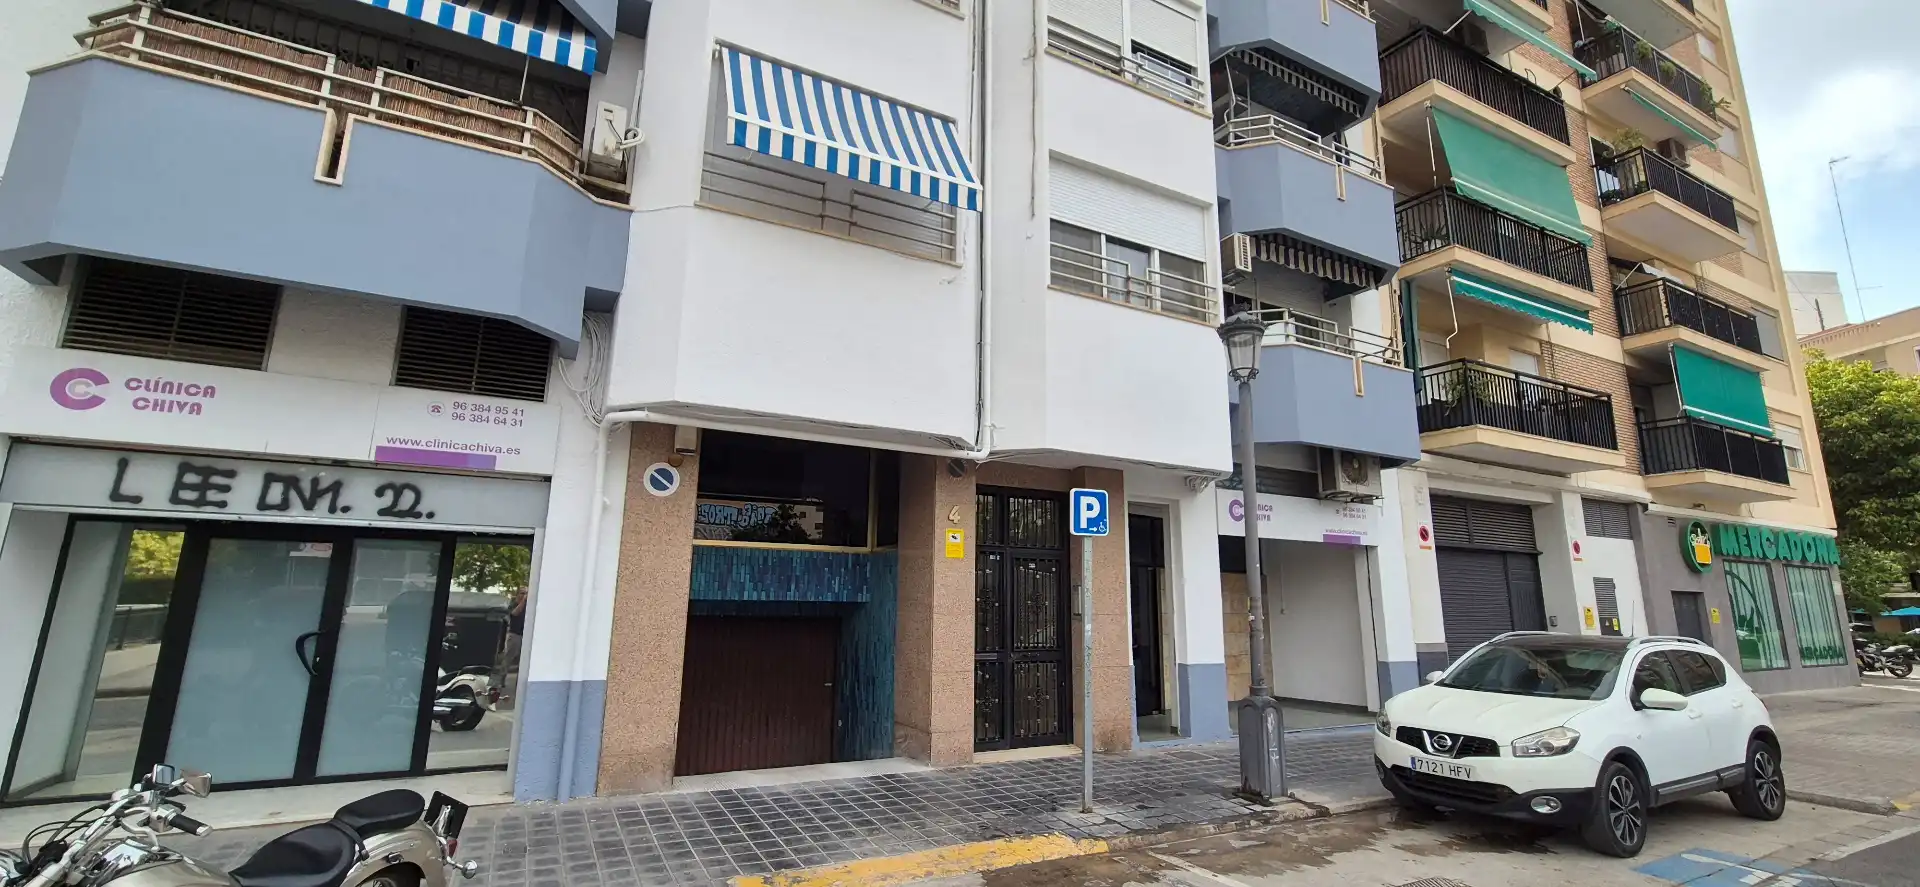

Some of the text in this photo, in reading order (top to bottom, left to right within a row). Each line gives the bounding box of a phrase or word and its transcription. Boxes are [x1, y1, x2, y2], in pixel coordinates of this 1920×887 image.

[124, 376, 216, 399] CLÍNICA
[132, 397, 203, 415] CHIVA
[452, 401, 524, 417] 96 384 95 41
[451, 412, 523, 427] 96 384 64 31
[386, 435, 521, 456] www.clinicachiva.es
[948, 504, 961, 525] 4
[1080, 495, 1100, 528] P
[1718, 523, 1841, 565] MERCADONA
[1417, 758, 1471, 779] 7121 HFV
